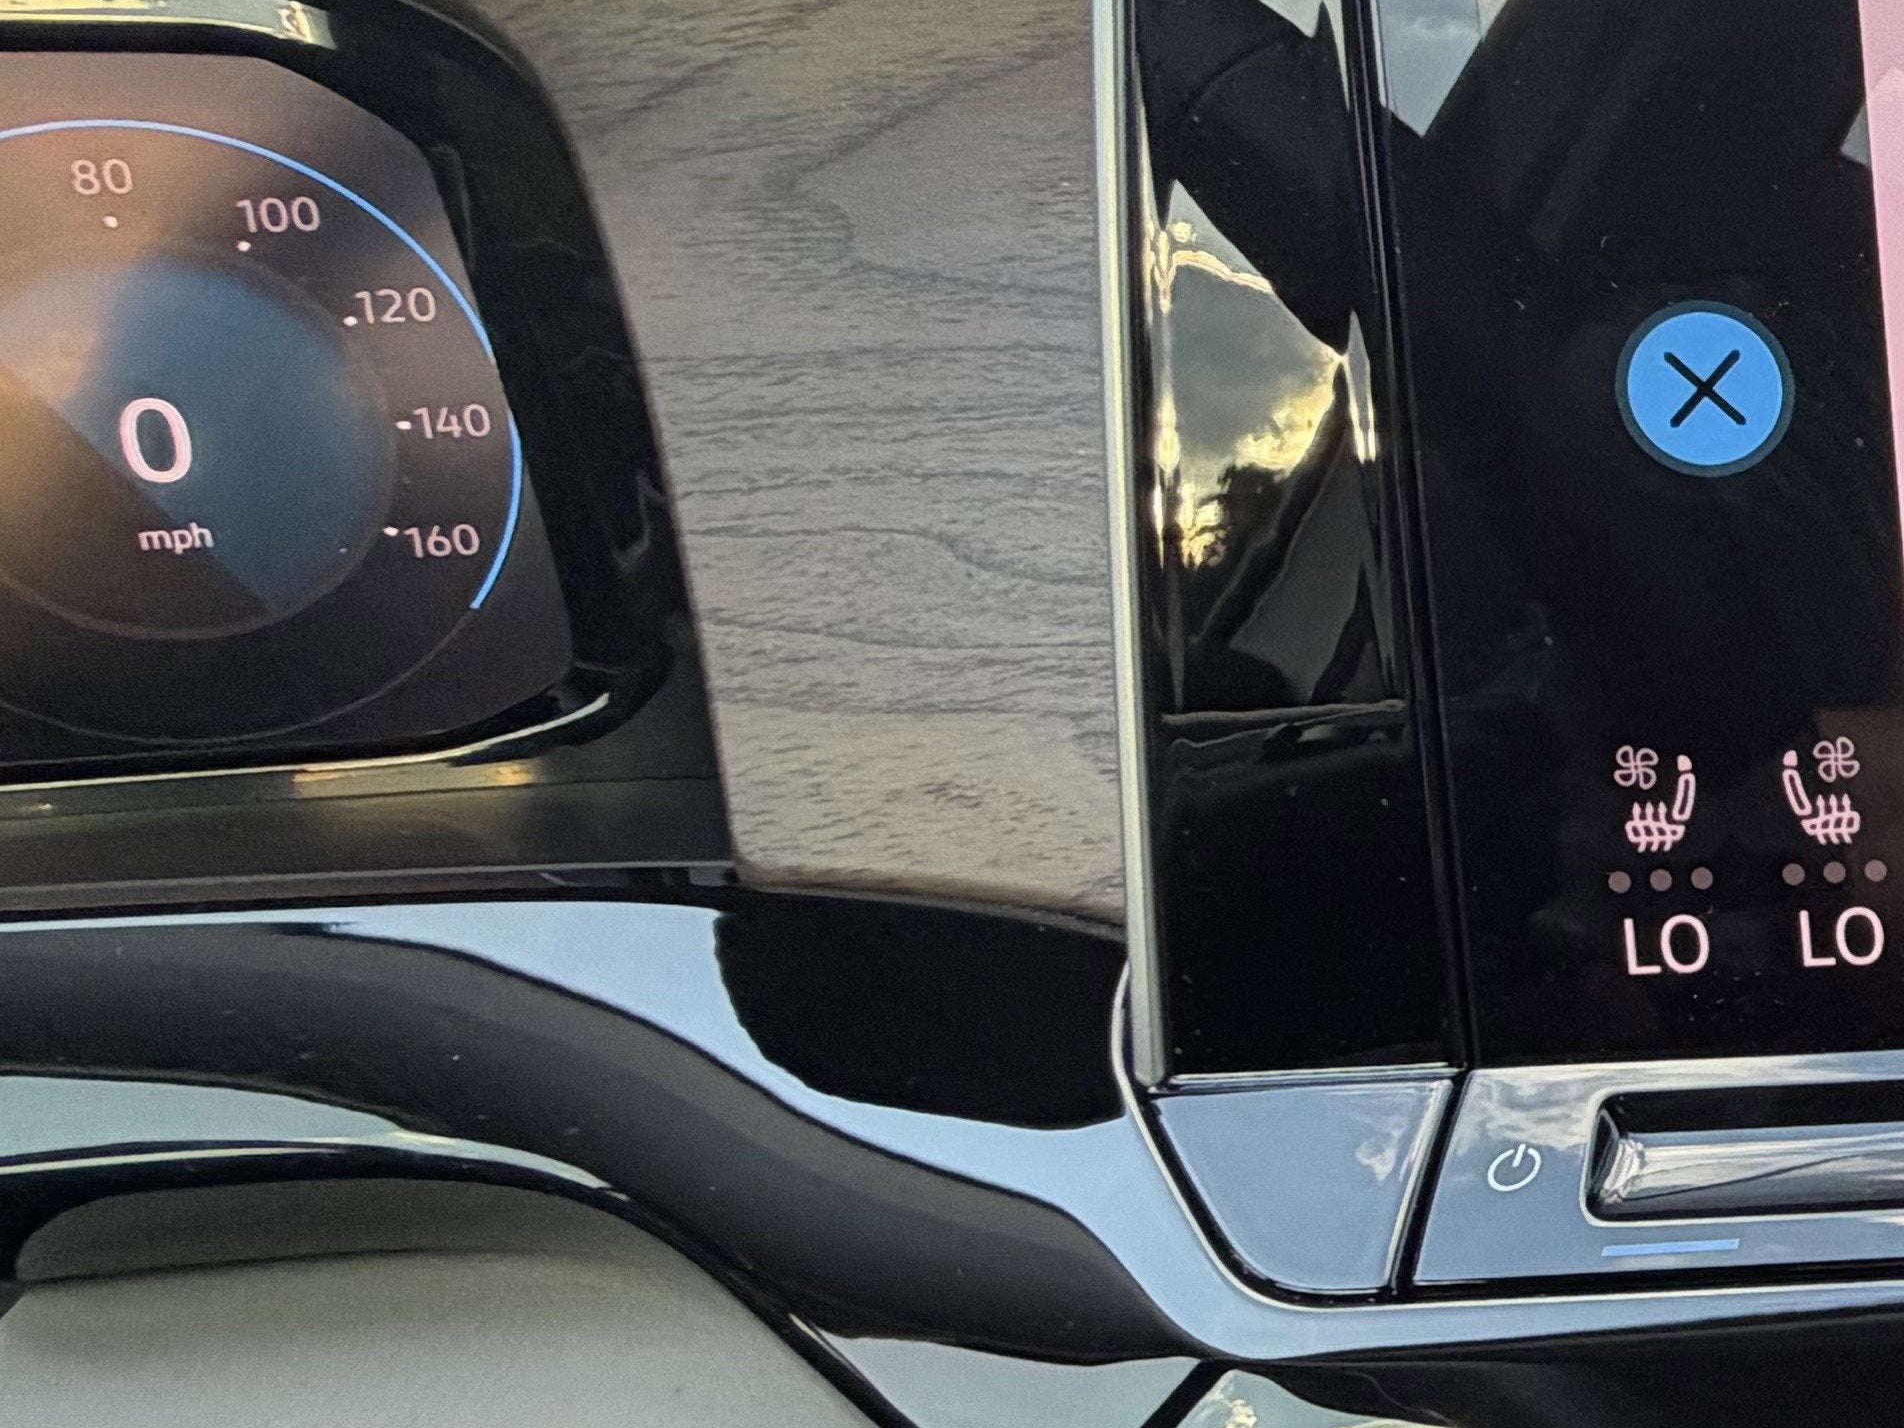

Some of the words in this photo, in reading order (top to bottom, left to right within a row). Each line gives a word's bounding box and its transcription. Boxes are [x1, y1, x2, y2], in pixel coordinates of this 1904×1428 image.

[70, 158, 134, 196] 80
[236, 196, 320, 234] 100
[355, 287, 437, 324] 120
[414, 403, 491, 439] 140
[118, 397, 193, 484] 0
[138, 523, 214, 555] mph
[406, 523, 481, 559] 160
[1623, 914, 1711, 975] LO
[1799, 906, 1886, 967] LO
